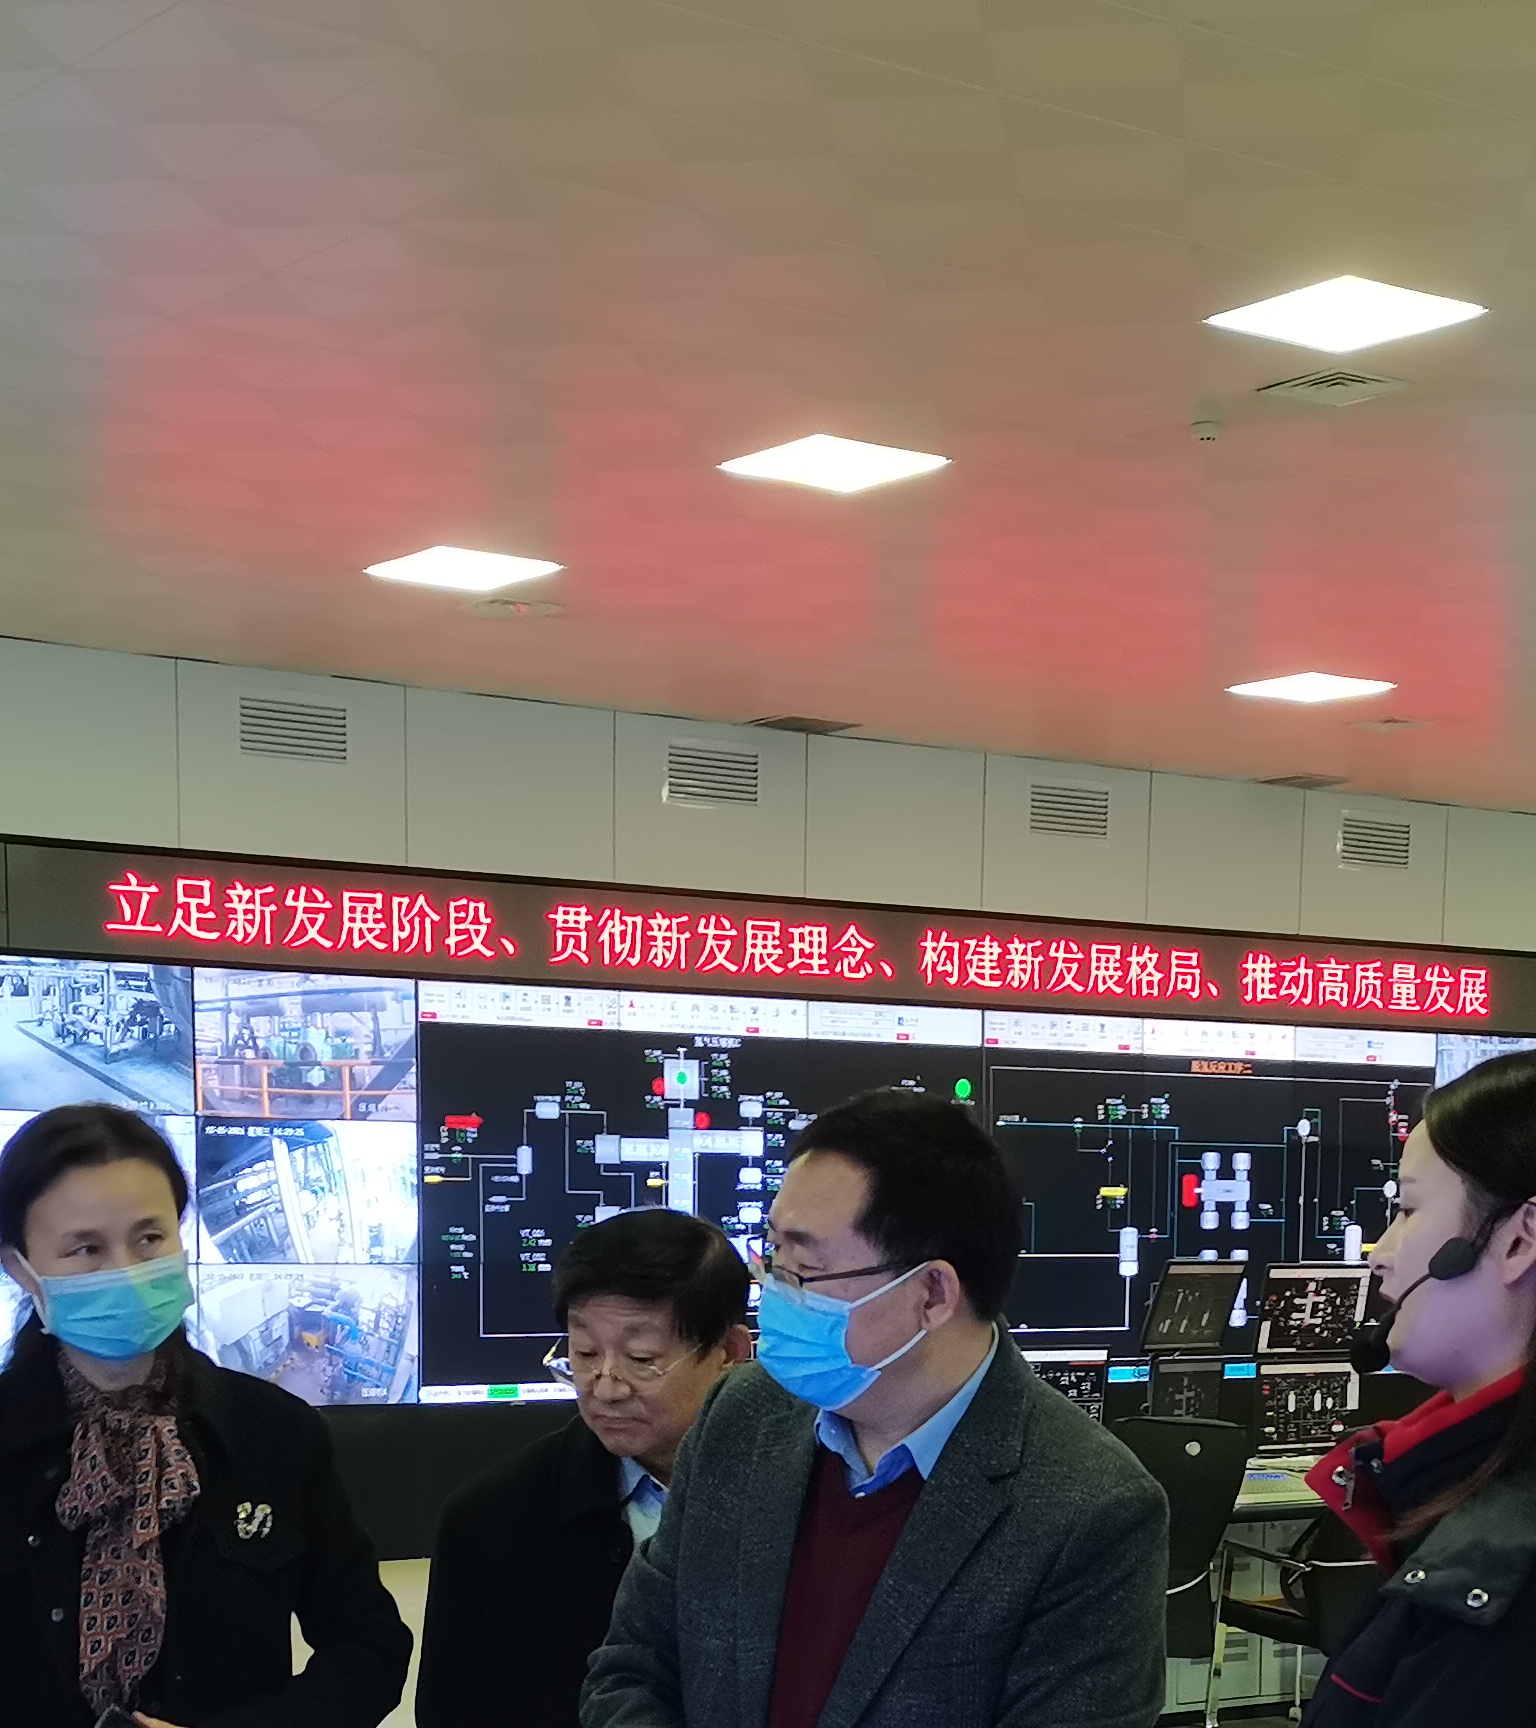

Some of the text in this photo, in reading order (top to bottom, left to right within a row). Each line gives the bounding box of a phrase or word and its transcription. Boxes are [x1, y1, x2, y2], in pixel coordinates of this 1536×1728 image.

[104, 871, 1490, 1017] 立足新发展阶段、贯彻新发展理念、构建新发展格局、推动高质量发展
